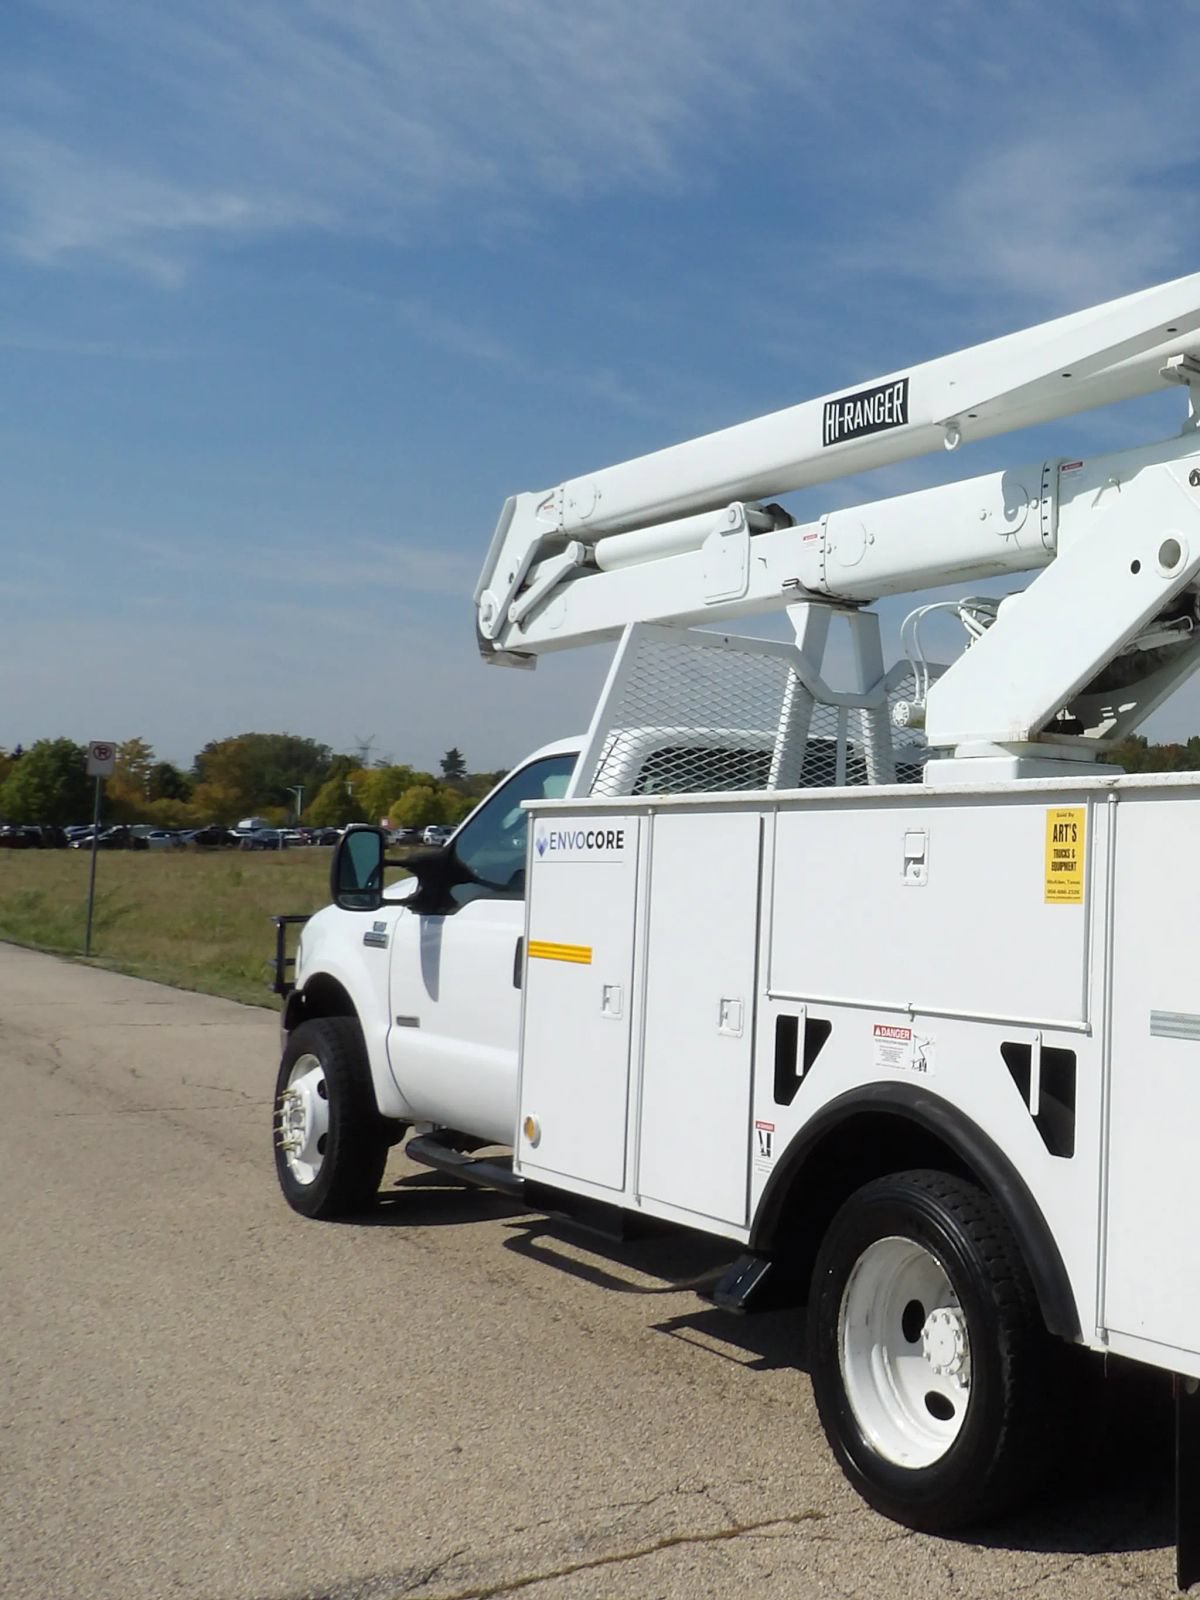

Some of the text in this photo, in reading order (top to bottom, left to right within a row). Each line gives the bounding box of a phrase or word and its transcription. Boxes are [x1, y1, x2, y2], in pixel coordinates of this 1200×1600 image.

[825, 381, 904, 445] HI-RANGER
[549, 830, 624, 850] ENVOCORE
[1052, 823, 1077, 843] ART'S
[1053, 848, 1070, 859] TRUCKS
[881, 1026, 910, 1040] DANGER
